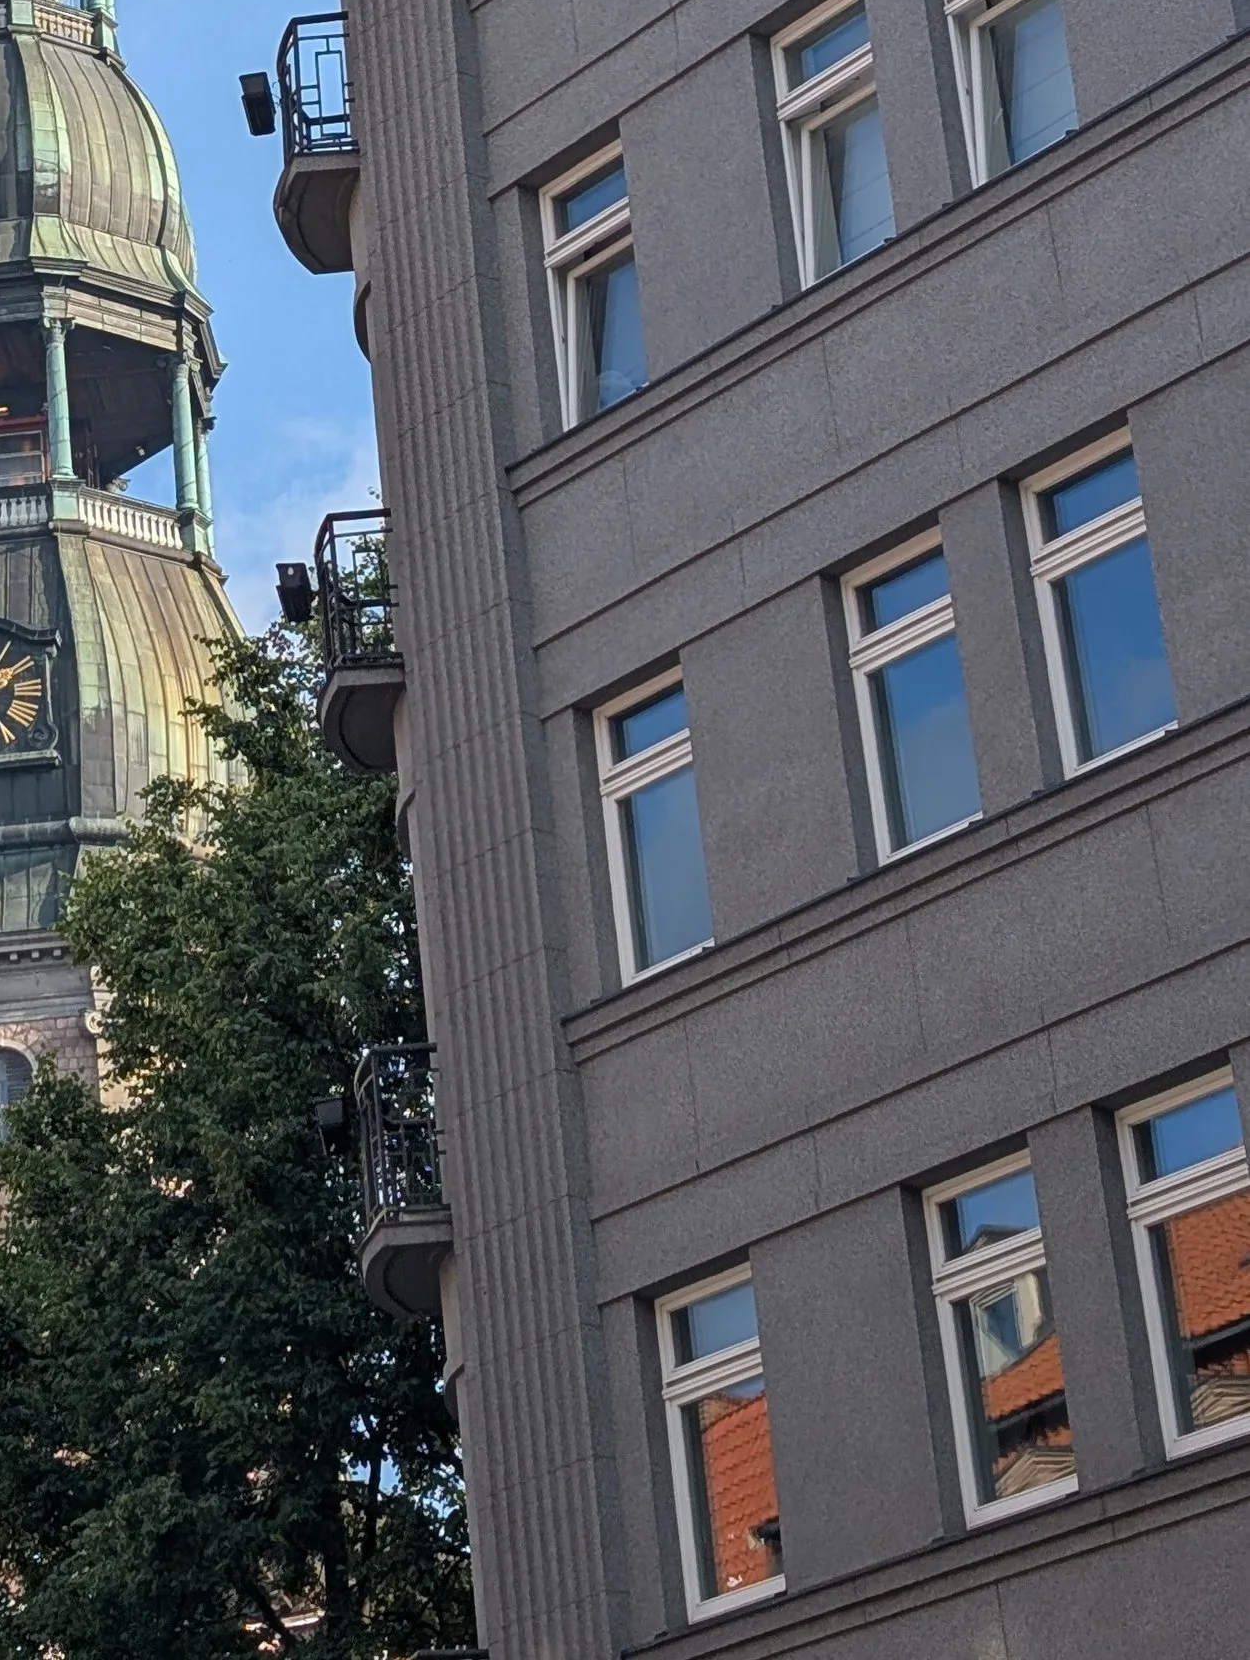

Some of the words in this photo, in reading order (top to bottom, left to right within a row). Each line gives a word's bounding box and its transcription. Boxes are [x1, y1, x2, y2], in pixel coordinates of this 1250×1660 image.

[11, 655, 35, 676] II
[14, 678, 42, 697] III
[6, 700, 39, 727] IIII
